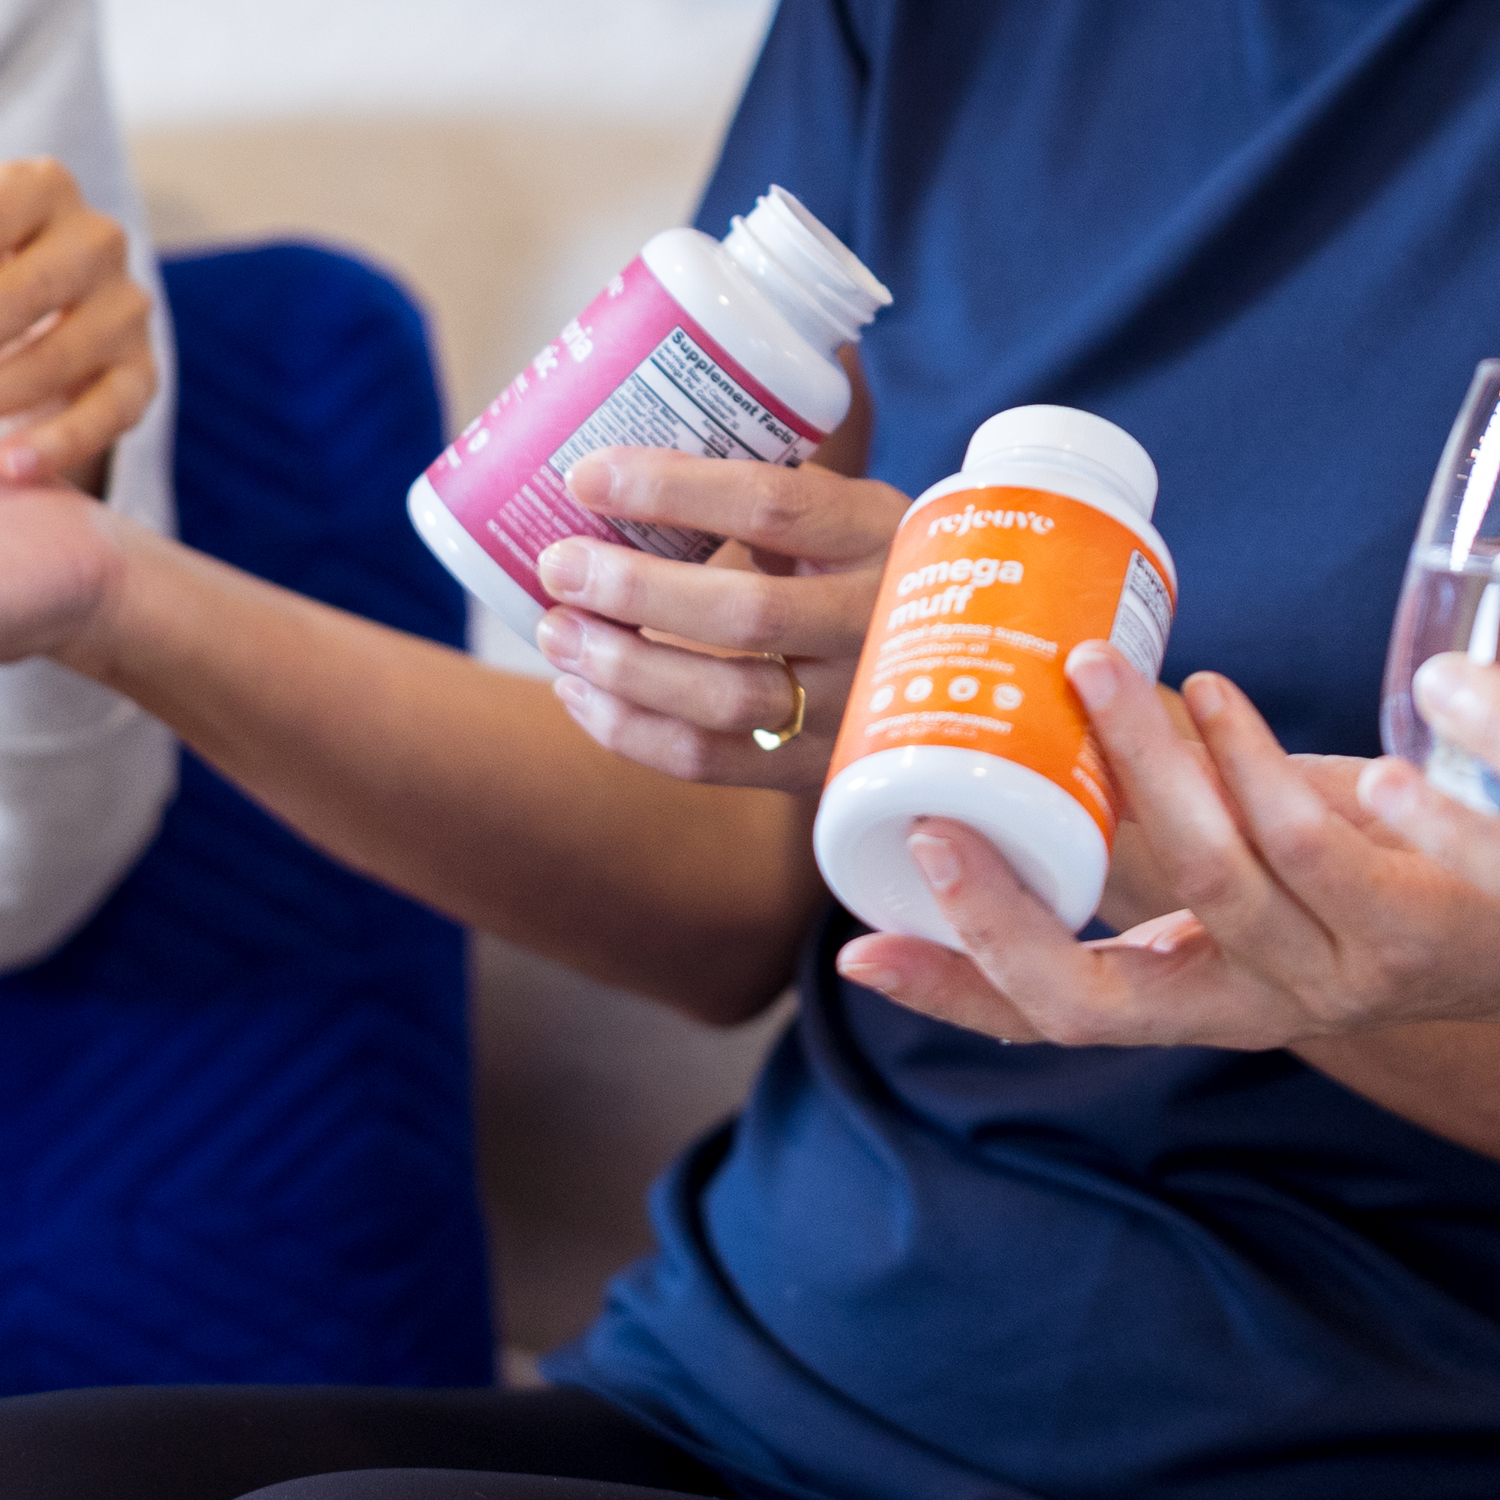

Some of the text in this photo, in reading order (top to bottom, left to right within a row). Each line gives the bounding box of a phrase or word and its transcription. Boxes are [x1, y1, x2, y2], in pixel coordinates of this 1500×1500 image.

[628, 375, 678, 426] Proprietary Blend
[654, 348, 685, 380] Servings
[683, 376, 696, 391] Per
[694, 388, 731, 423] Container:
[661, 341, 687, 370] Serving
[685, 366, 704, 385] Size:
[707, 387, 738, 418] Capsules
[670, 329, 795, 445] Supplement Facts
[927, 503, 1054, 536] rejeuve
[896, 557, 1024, 596] omega
[886, 584, 975, 629] muff
[929, 623, 992, 637] dryness
[993, 625, 1059, 654] support
[965, 641, 988, 653] oil
